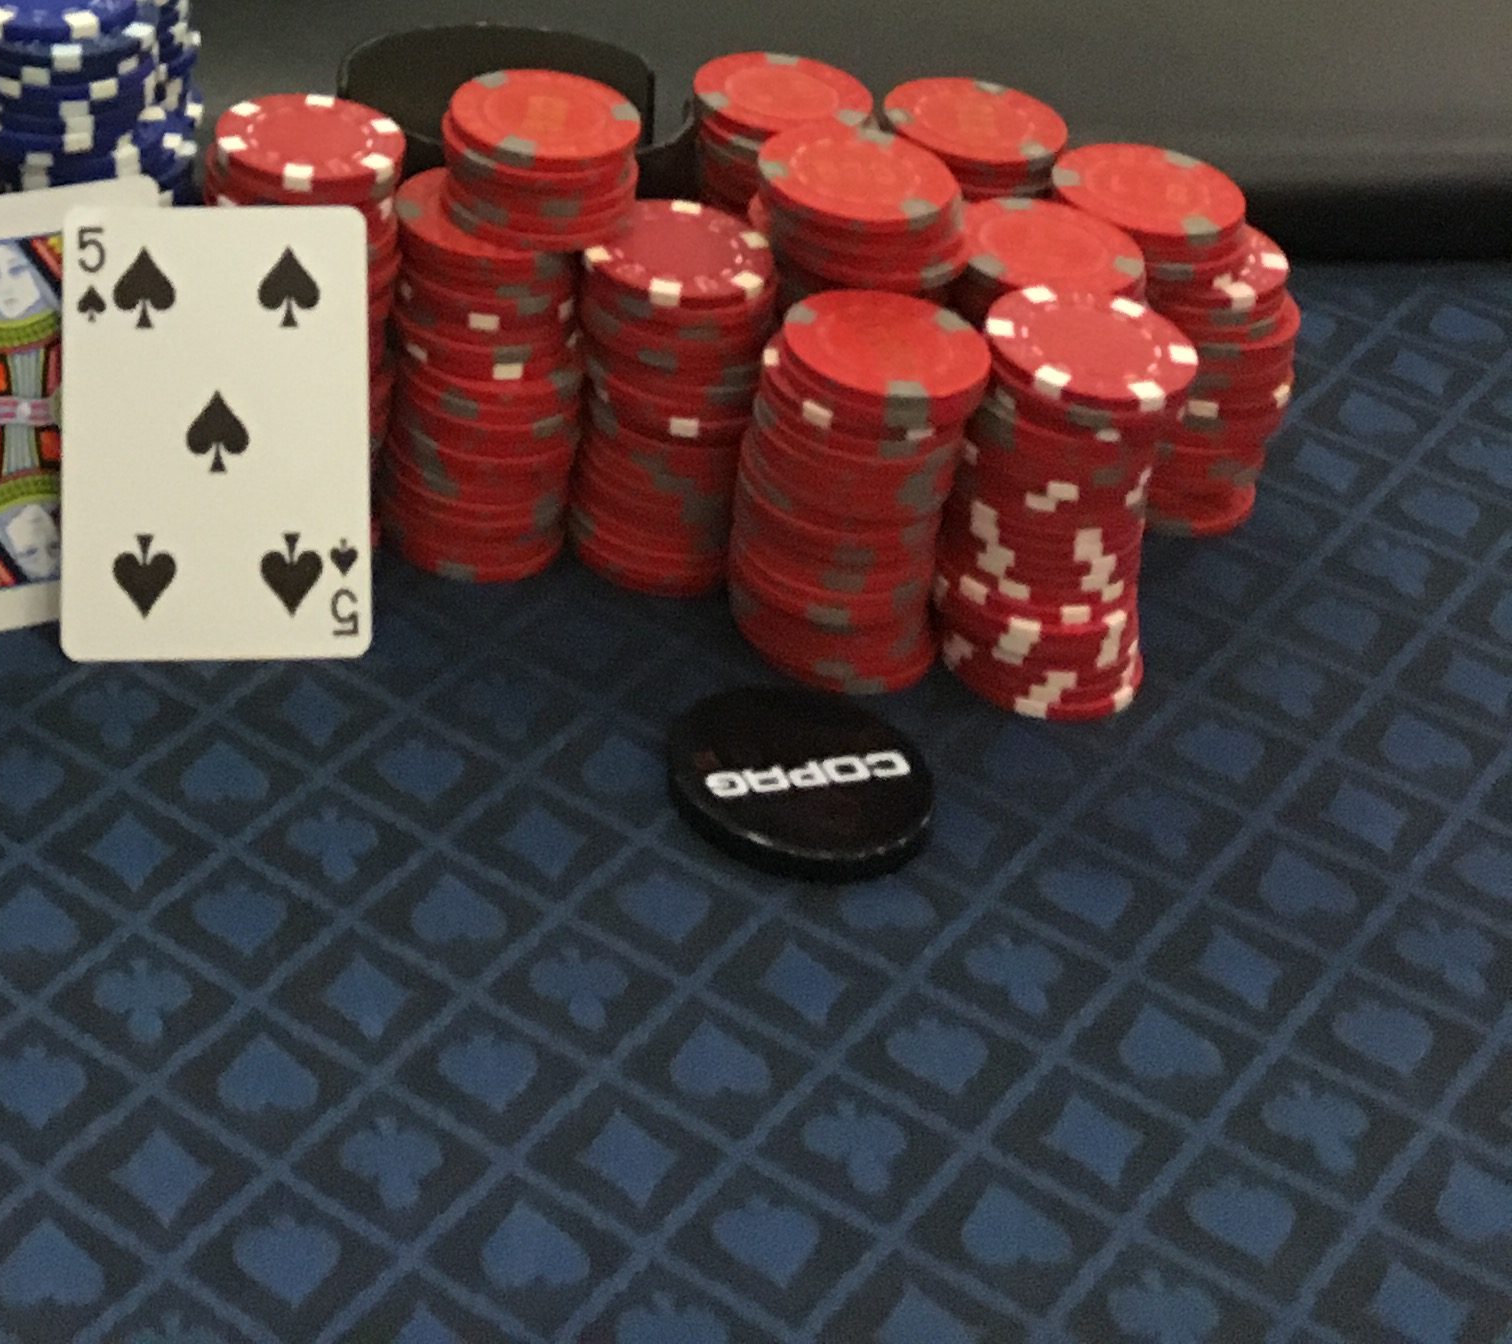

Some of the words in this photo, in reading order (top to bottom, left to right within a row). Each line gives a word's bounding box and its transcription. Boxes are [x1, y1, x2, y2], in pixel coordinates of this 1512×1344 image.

[76, 227, 106, 273] 5
[330, 587, 360, 637] 5
[704, 749, 912, 799] COPAG
